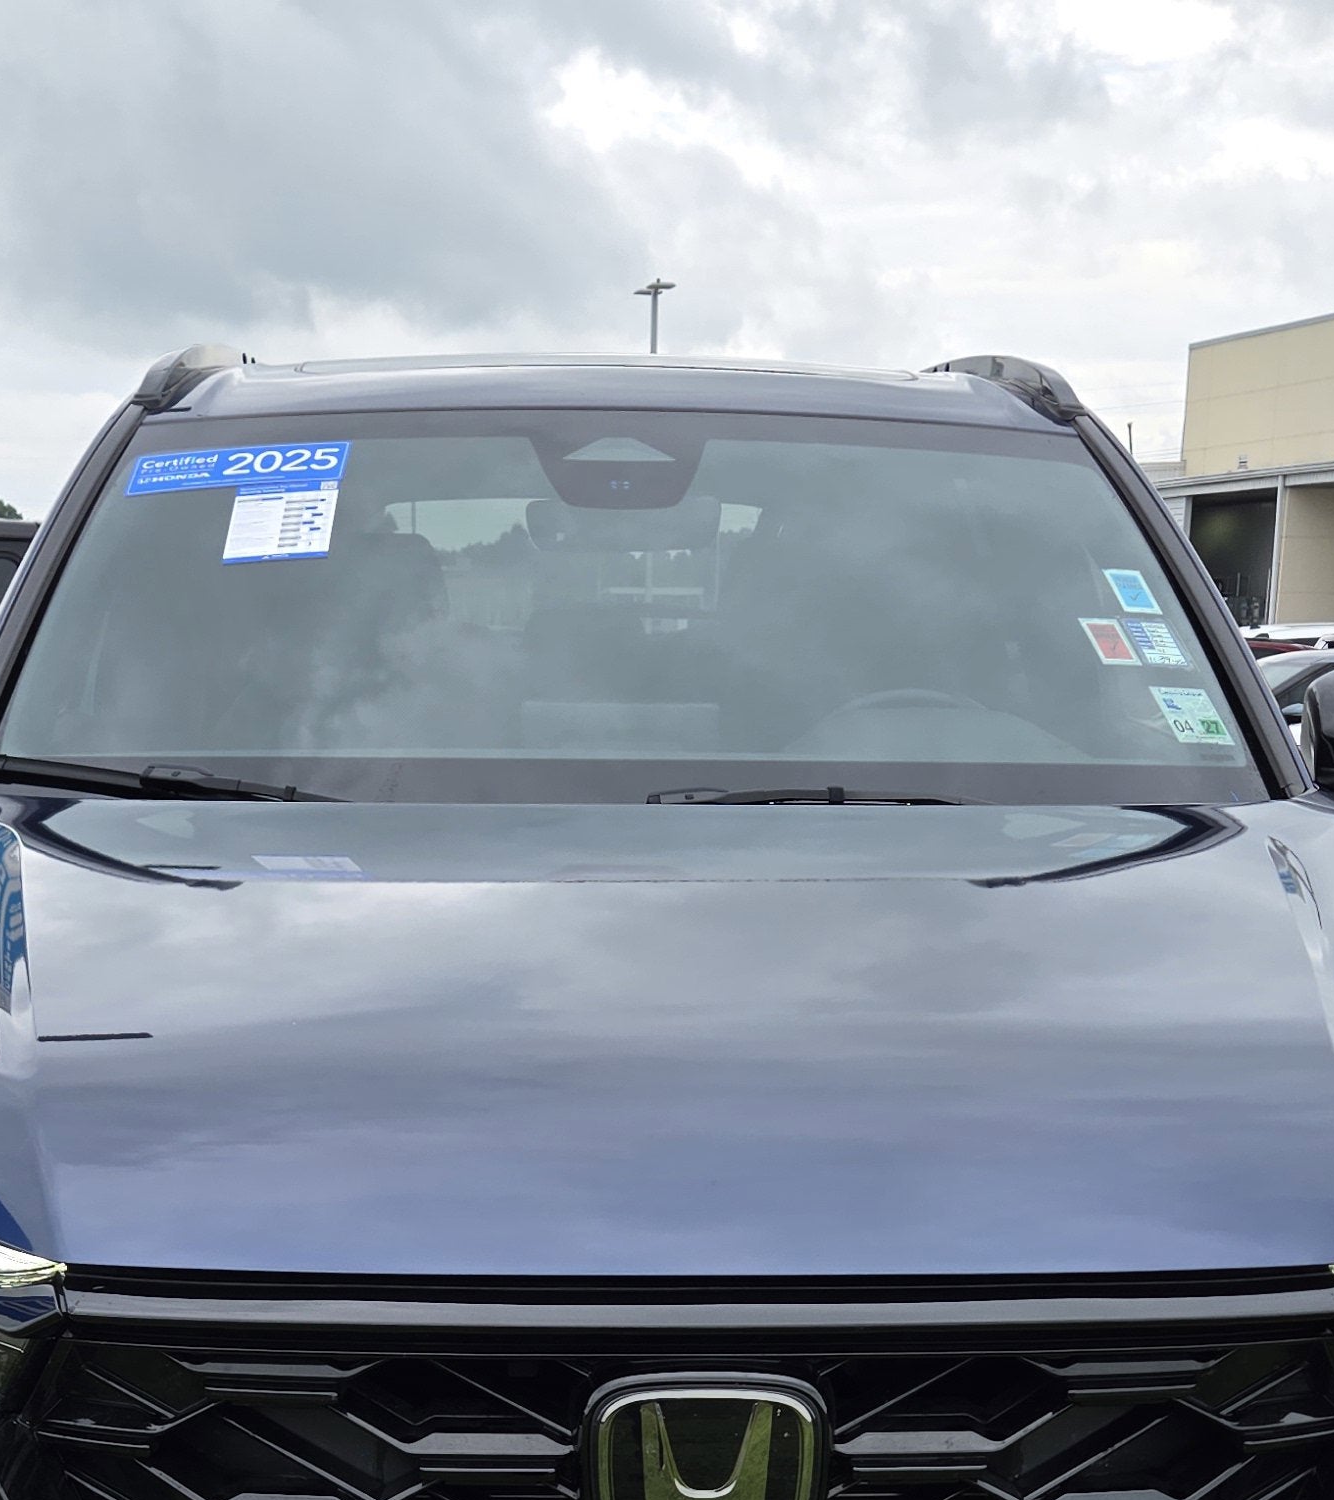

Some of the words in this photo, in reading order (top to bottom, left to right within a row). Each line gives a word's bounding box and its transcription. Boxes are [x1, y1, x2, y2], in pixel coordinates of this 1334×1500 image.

[141, 454, 219, 469] Certified
[222, 448, 340, 476] 2025
[152, 472, 211, 483] HONDA
[1173, 719, 1195, 733] 04
